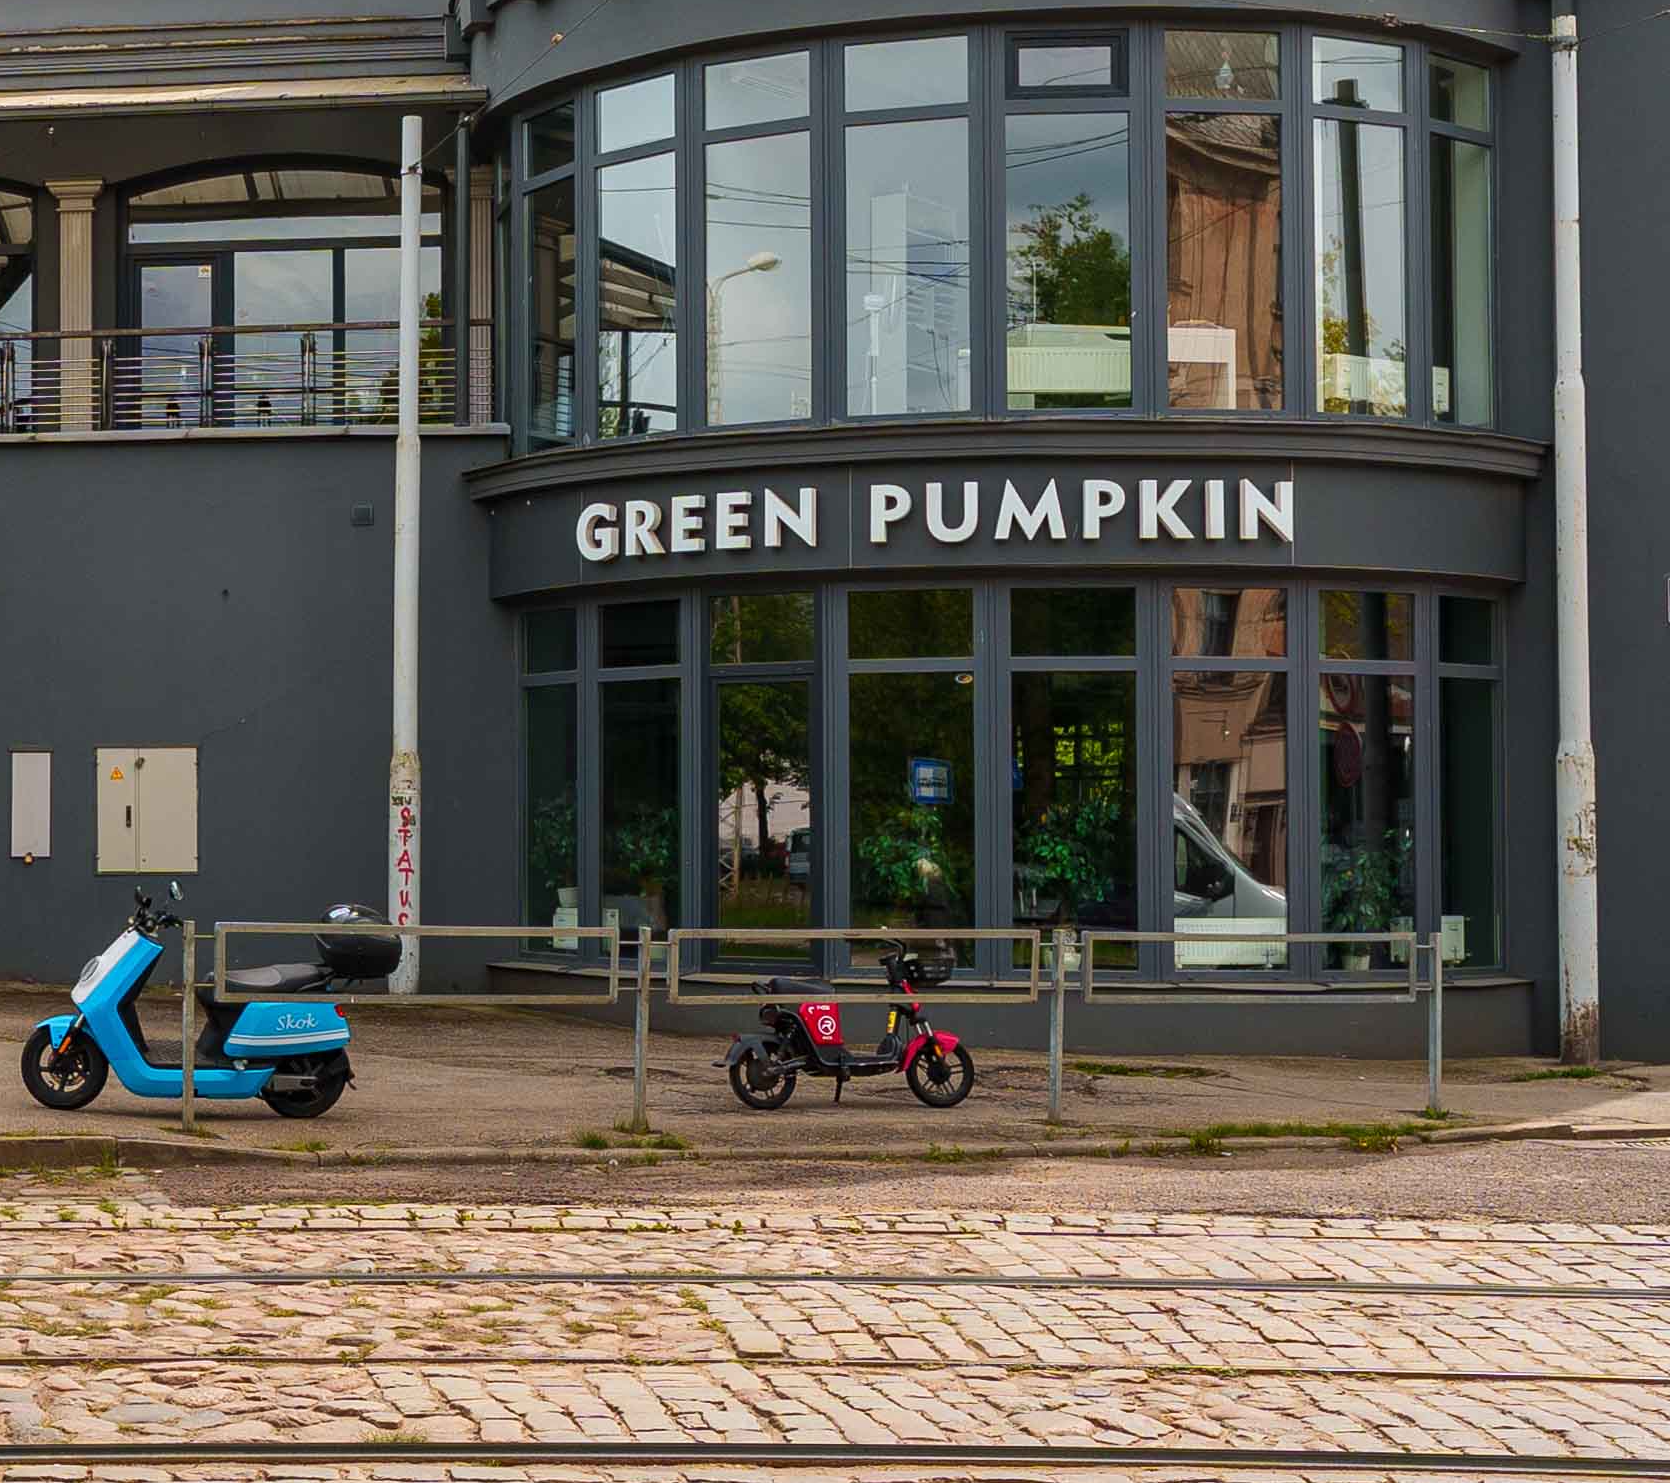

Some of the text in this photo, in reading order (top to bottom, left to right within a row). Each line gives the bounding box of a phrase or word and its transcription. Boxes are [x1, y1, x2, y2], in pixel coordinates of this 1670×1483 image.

[576, 478, 1293, 561] GREEN PUMPKIN
[276, 1013, 318, 1031] Skok
